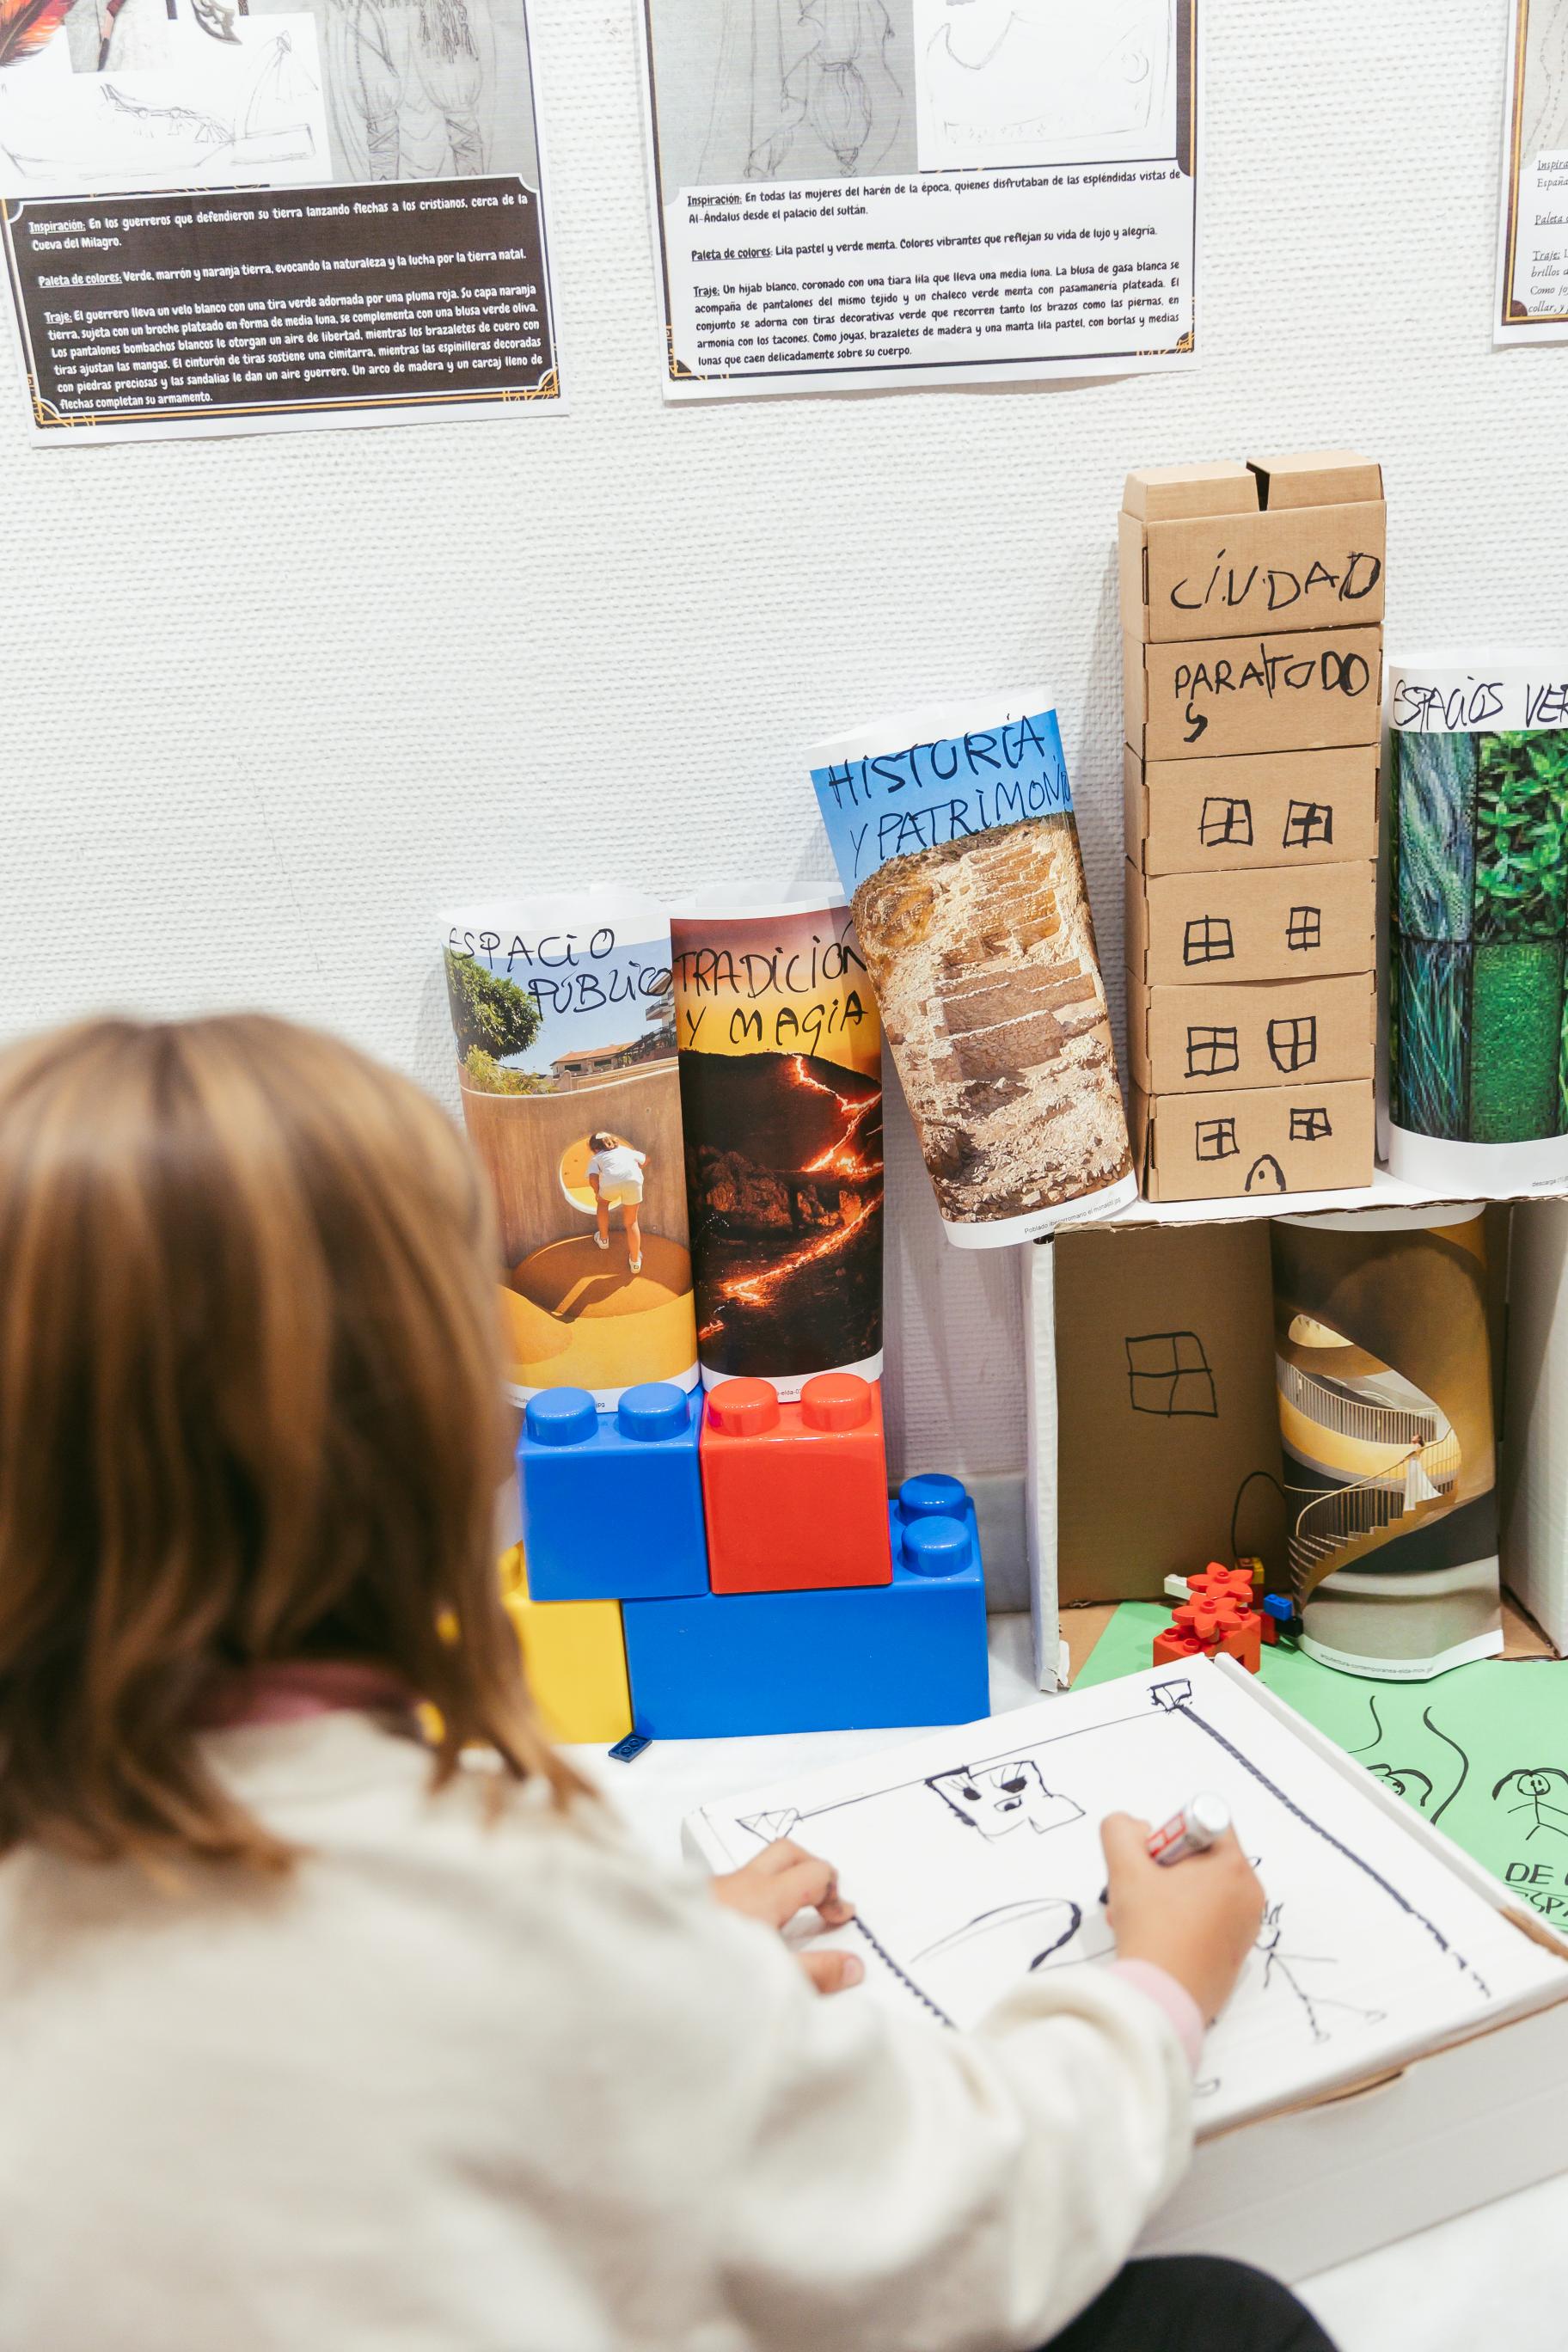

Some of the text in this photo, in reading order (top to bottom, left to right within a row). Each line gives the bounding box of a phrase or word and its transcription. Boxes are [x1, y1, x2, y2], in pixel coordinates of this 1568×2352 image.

[744, 192, 756, 203] En
[759, 190, 786, 202] todas
[788, 190, 802, 200] las
[805, 188, 842, 202] mujeres
[845, 186, 860, 197] del
[863, 186, 891, 196] harén
[894, 183, 906, 194] de
[909, 183, 918, 193] la
[954, 181, 989, 194] quienes
[993, 176, 1049, 189] disfrutaban
[1051, 175, 1063, 186] de
[1067, 175, 1080, 185] las
[1082, 171, 1136, 187] espléndidas
[1139, 170, 1166, 181] vistas
[1169, 169, 1180, 180] de
[89, 217, 101, 230] En
[105, 217, 119, 229] los
[122, 216, 171, 231] guerreros
[175, 214, 193, 228] que
[196, 210, 255, 224] defendieron
[258, 210, 270, 220] su
[272, 207, 303, 219] tierra
[306, 203, 350, 217] lanzando
[352, 202, 389, 214] flechas
[392, 203, 399, 212] a
[402, 200, 416, 211] los
[420, 198, 469, 211] cristianos,
[471, 197, 499, 207] cerca
[502, 193, 515, 205] de
[518, 193, 528, 205] la
[689, 211, 740, 224] Al-Ándalus
[743, 209, 769, 221] desde
[772, 209, 781, 219] el
[783, 208, 818, 223] palacio
[819, 205, 835, 217] del
[1534, 211, 1563, 225] Paleta
[32, 236, 122, 251] Cueva del Milagro.
[691, 248, 722, 262] Paleta
[724, 248, 735, 260] de
[738, 247, 773, 260] colores:
[775, 245, 793, 256] Lila
[795, 243, 824, 258] pastel
[827, 245, 834, 256] y
[836, 240, 864, 253] verde
[866, 240, 897, 251] menta.
[899, 238, 934, 249] Colores
[936, 235, 982, 247] vibrantes
[983, 235, 1001, 248] que
[1003, 232, 1042, 245] reflejan
[1044, 232, 1054, 241] su
[1057, 229, 1077, 241] vida
[1079, 228, 1091, 239] de
[1093, 228, 1111, 242] lujo
[1113, 230, 1119, 241] y
[38, 248, 526, 289] Paleta de colores: Verde, marrón y naranja tierra, evocando la naturaleza y la lucha por la tierra natal.
[693, 261, 1179, 299] Traje: Un hijab blanco, coronado con una tiara lila que lleva una media luna. La blusa de gasa blanca se
[1531, 265, 1559, 278] brillos
[695, 277, 1179, 315] acompaña de pantalones del mismo tejido y un chaleco verde menta con pasamanería plateada. El
[1530, 285, 1555, 295] Como
[59, 391, 213, 410] flechas completan su armamento.
[1505, 1862, 1554, 1885] DE
